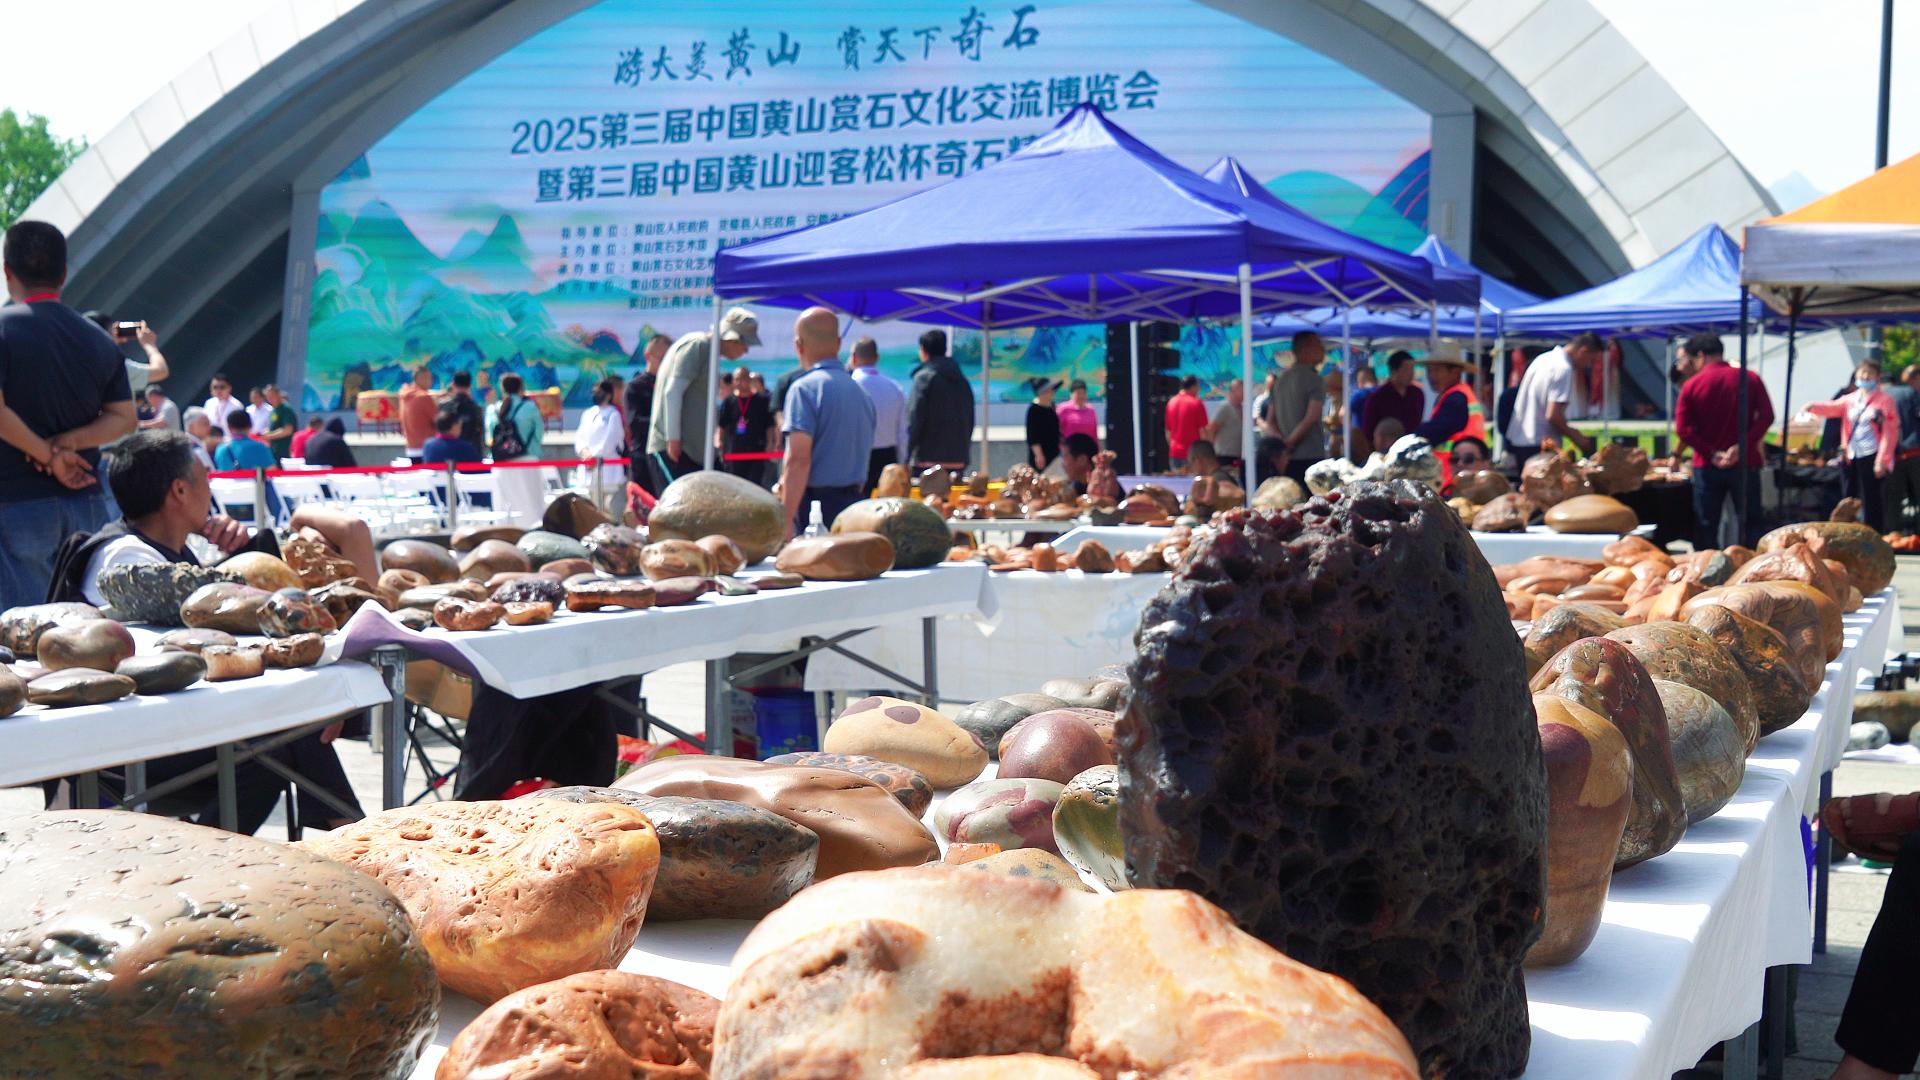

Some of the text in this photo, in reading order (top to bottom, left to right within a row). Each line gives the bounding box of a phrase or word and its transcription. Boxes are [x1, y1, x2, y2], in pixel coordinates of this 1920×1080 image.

[613, 26, 800, 88] 游大美黄山
[511, 70, 1159, 155] 2025第三届中国黄山赏石文化交流博览会
